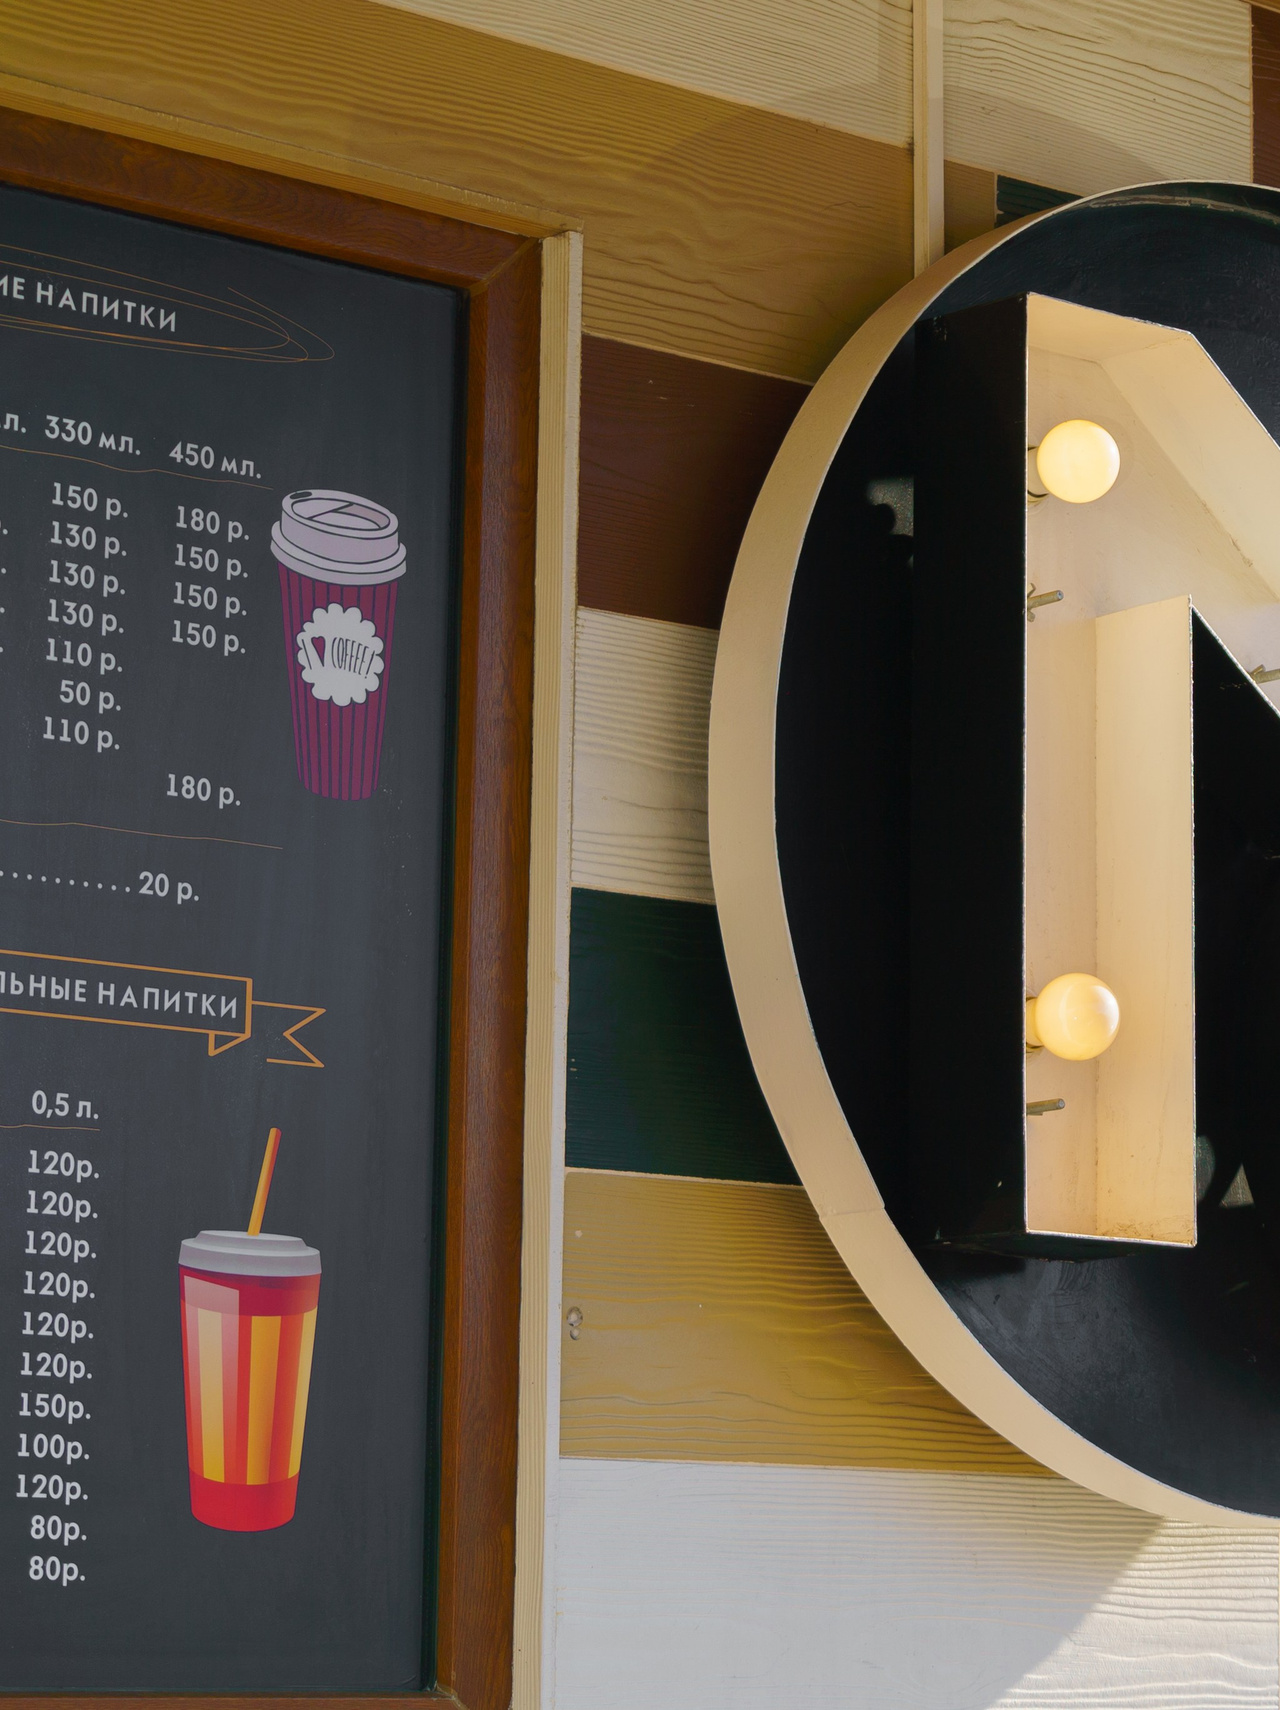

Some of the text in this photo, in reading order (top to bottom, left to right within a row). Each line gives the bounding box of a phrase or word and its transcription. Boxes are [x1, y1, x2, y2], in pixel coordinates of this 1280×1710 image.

[36, 281, 177, 333] НАПИТКИ
[44, 414, 93, 446] 330
[98, 432, 141, 456] мл.
[168, 441, 215, 469] 450
[220, 456, 262, 479] мл.
[51, 481, 128, 521] 150 р.
[50, 520, 127, 559] 130 р.
[176, 505, 250, 543] 180 р.
[48, 559, 126, 598] 130 р.
[174, 543, 249, 581] 150 р.
[47, 598, 124, 637] 130 р.
[173, 581, 247, 619] 150 р.
[45, 637, 123, 675] 110 р.
[171, 619, 246, 657] 150 р.
[331, 636, 376, 679] COFFEE!
[59, 679, 122, 715] 50 р.
[42, 715, 120, 753] 110 р.
[166, 773, 241, 810] 180 р.
[138, 870, 200, 905] 20 р.
[98, 981, 237, 1019] НАПИТКИ
[31, 1089, 99, 1120] 0,5 л.
[27, 1149, 100, 1184] 120р.
[26, 1189, 98, 1224] 120р.
[24, 1230, 97, 1264] 120р.
[23, 1270, 96, 1304] 120р.
[21, 1311, 94, 1344] 120р.
[20, 1351, 93, 1385] 120р.
[18, 1392, 91, 1425] 150р.
[17, 1433, 90, 1465] 100р.
[16, 1473, 89, 1506] 120р.
[30, 1514, 87, 1547] 80р.
[28, 1555, 86, 1587] 80р.
